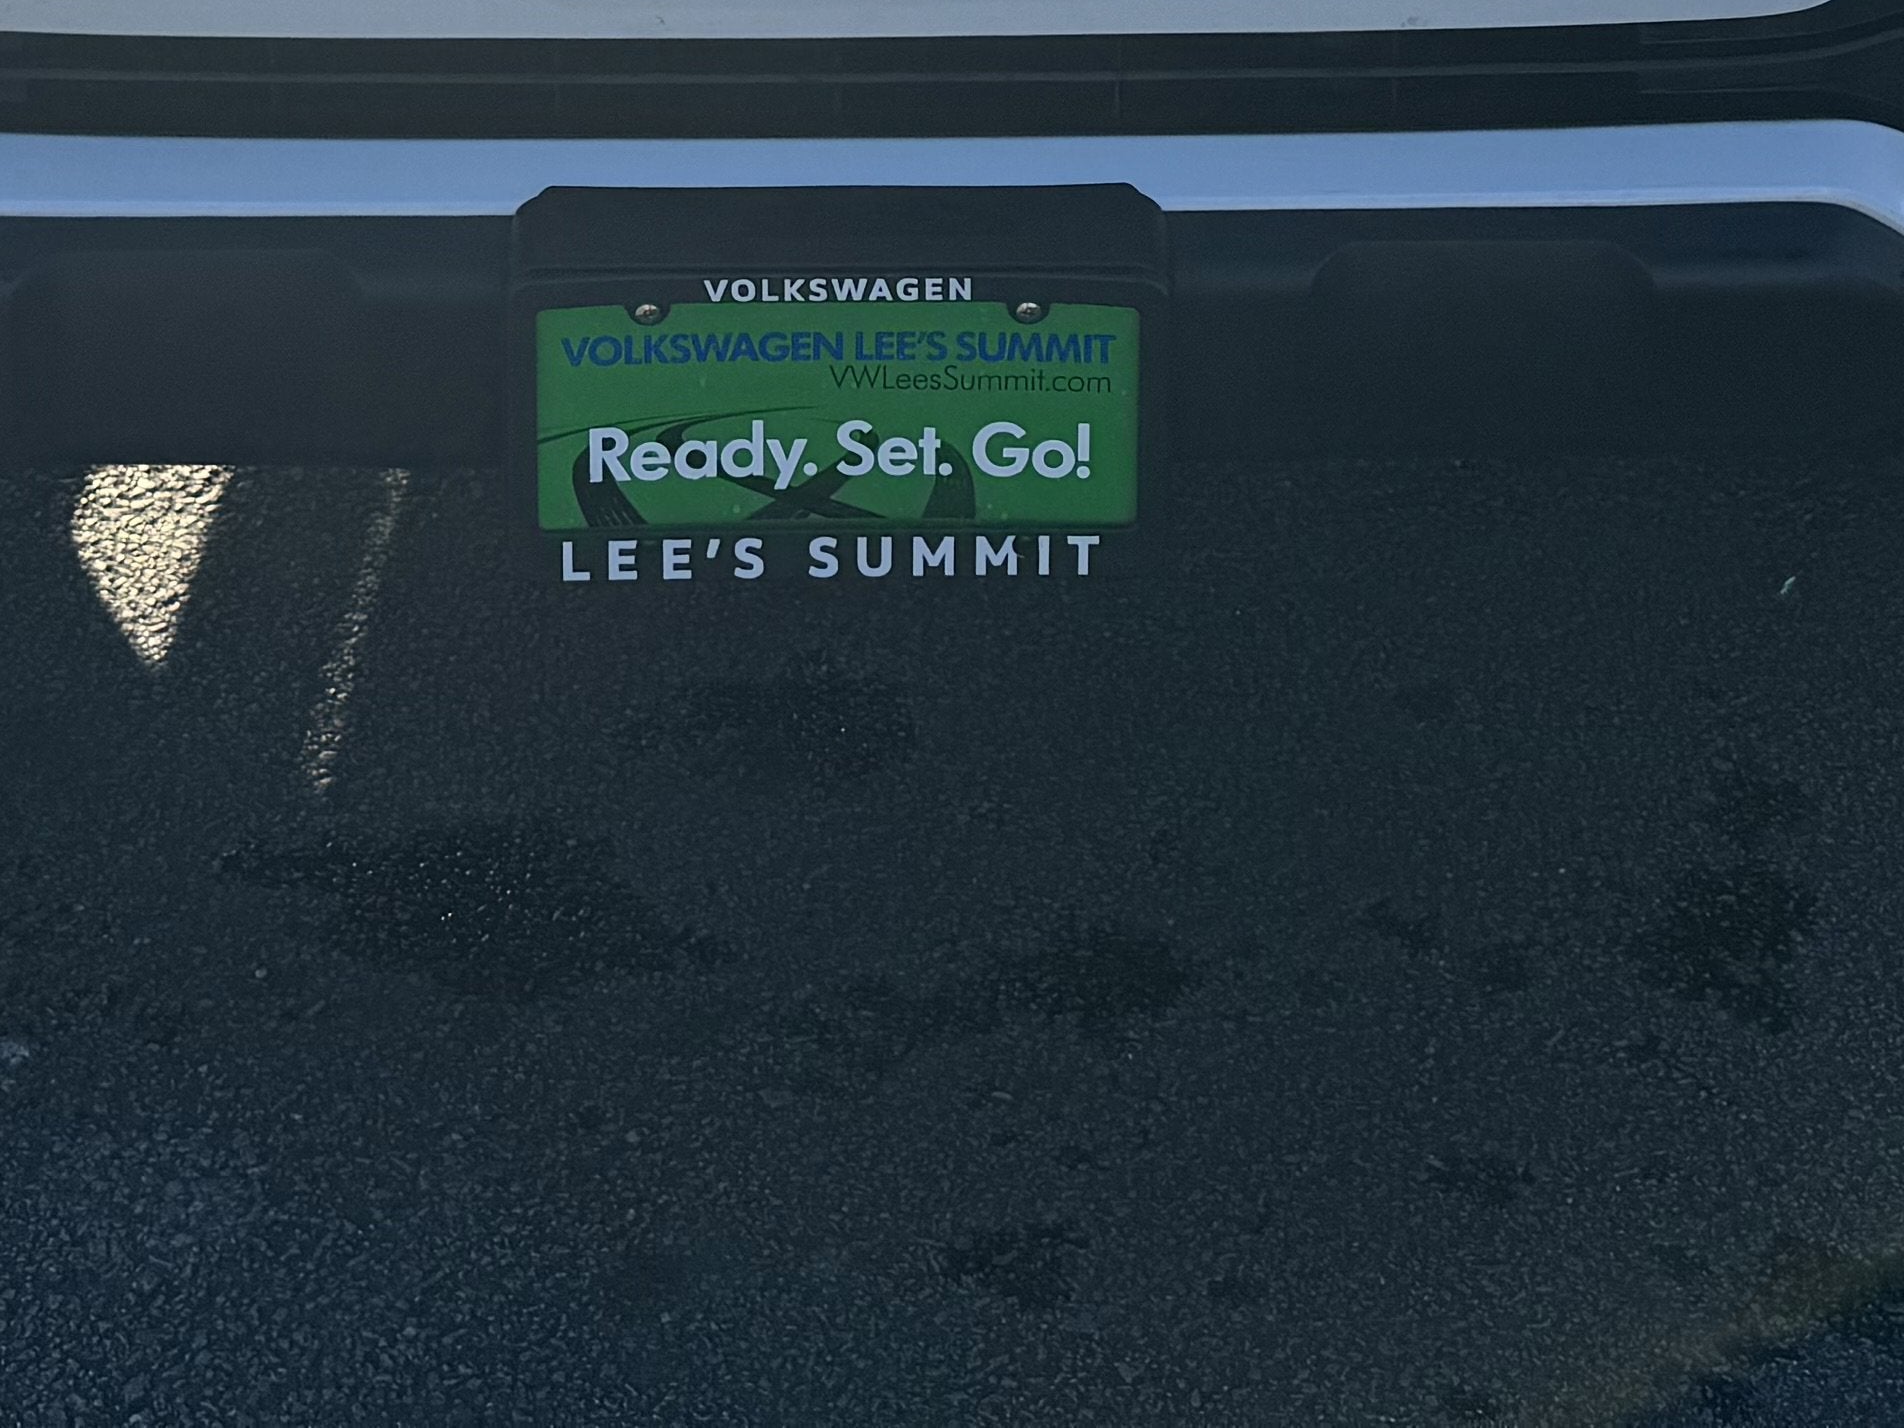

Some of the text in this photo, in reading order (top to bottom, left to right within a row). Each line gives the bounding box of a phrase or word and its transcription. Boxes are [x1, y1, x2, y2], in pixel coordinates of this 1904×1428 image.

[703, 277, 972, 303] VOLKSWAGEN
[560, 330, 1117, 368] VOLKSWAGEN LEE'S SUMMIT
[828, 364, 1112, 393] VWLeesSummit.com
[588, 419, 1091, 491] Ready. Set. Go!
[561, 534, 1101, 582] LEE'S SUMMIT
